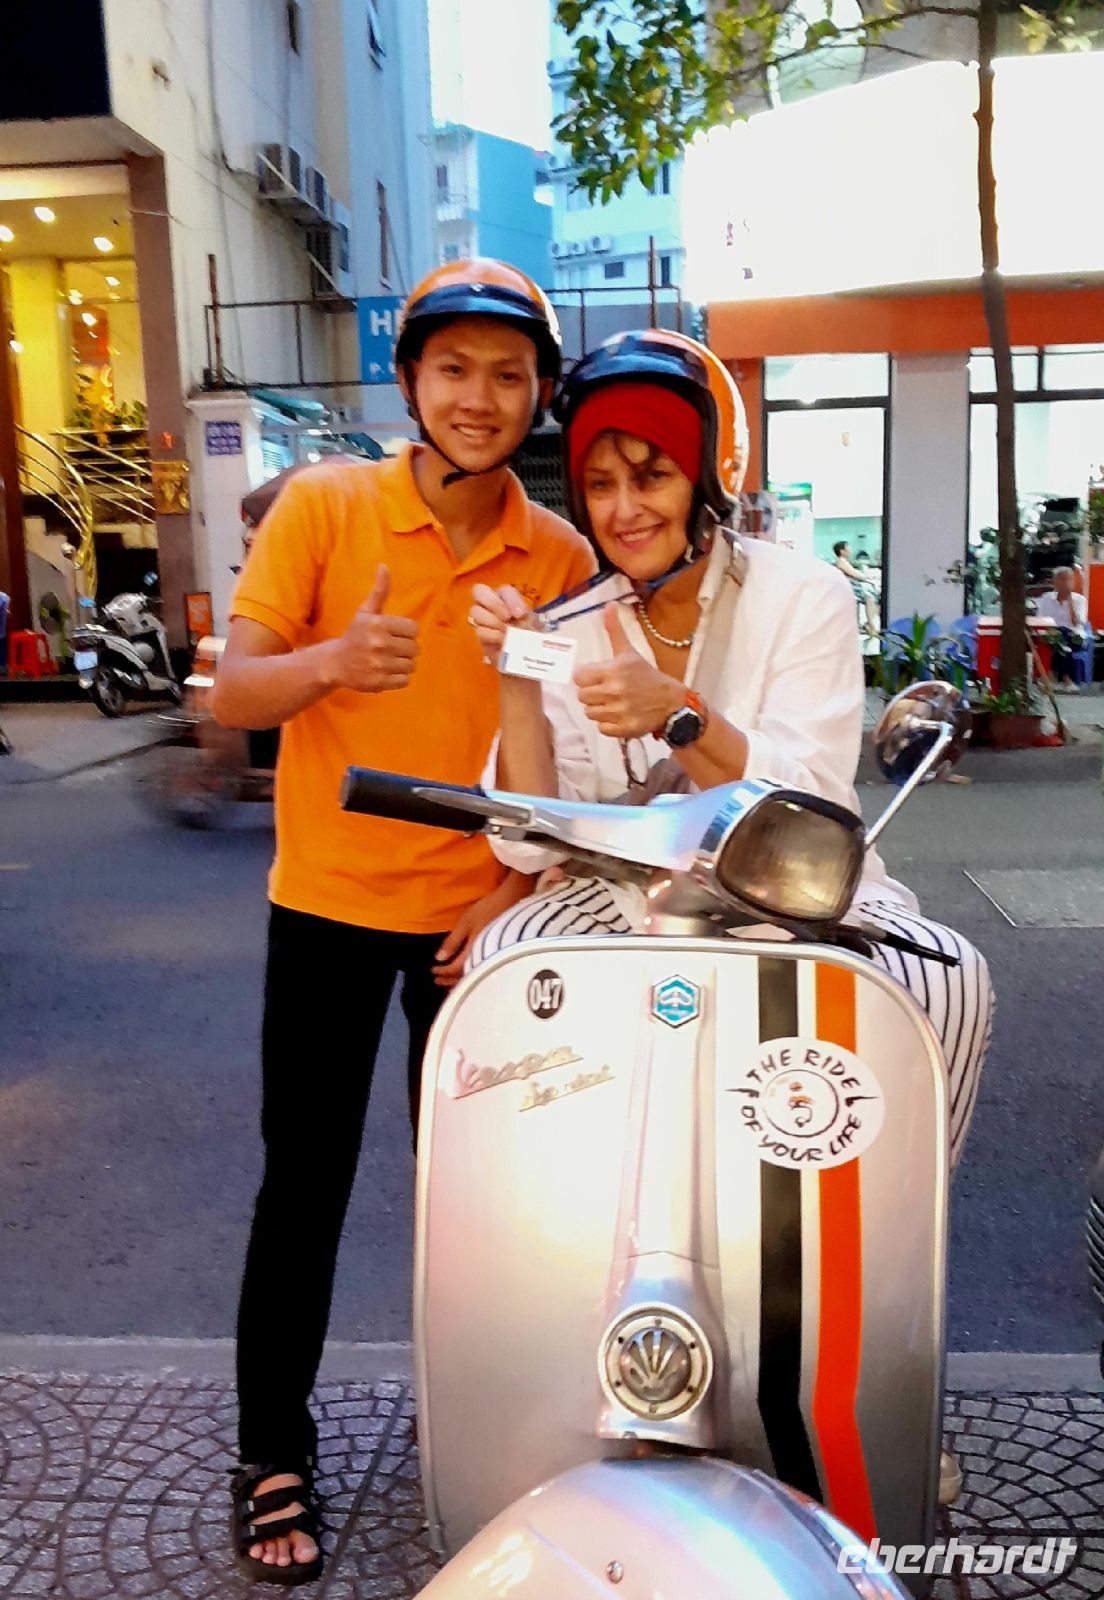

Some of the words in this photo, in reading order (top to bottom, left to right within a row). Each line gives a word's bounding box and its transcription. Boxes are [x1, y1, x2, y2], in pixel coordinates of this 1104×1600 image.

[530, 978, 563, 1010] 047
[746, 1049, 791, 1083] THE
[804, 1049, 861, 1089] RIDE
[741, 1105, 763, 1132] OF
[757, 1134, 823, 1162] YOUR
[829, 1113, 862, 1155] LIFE
